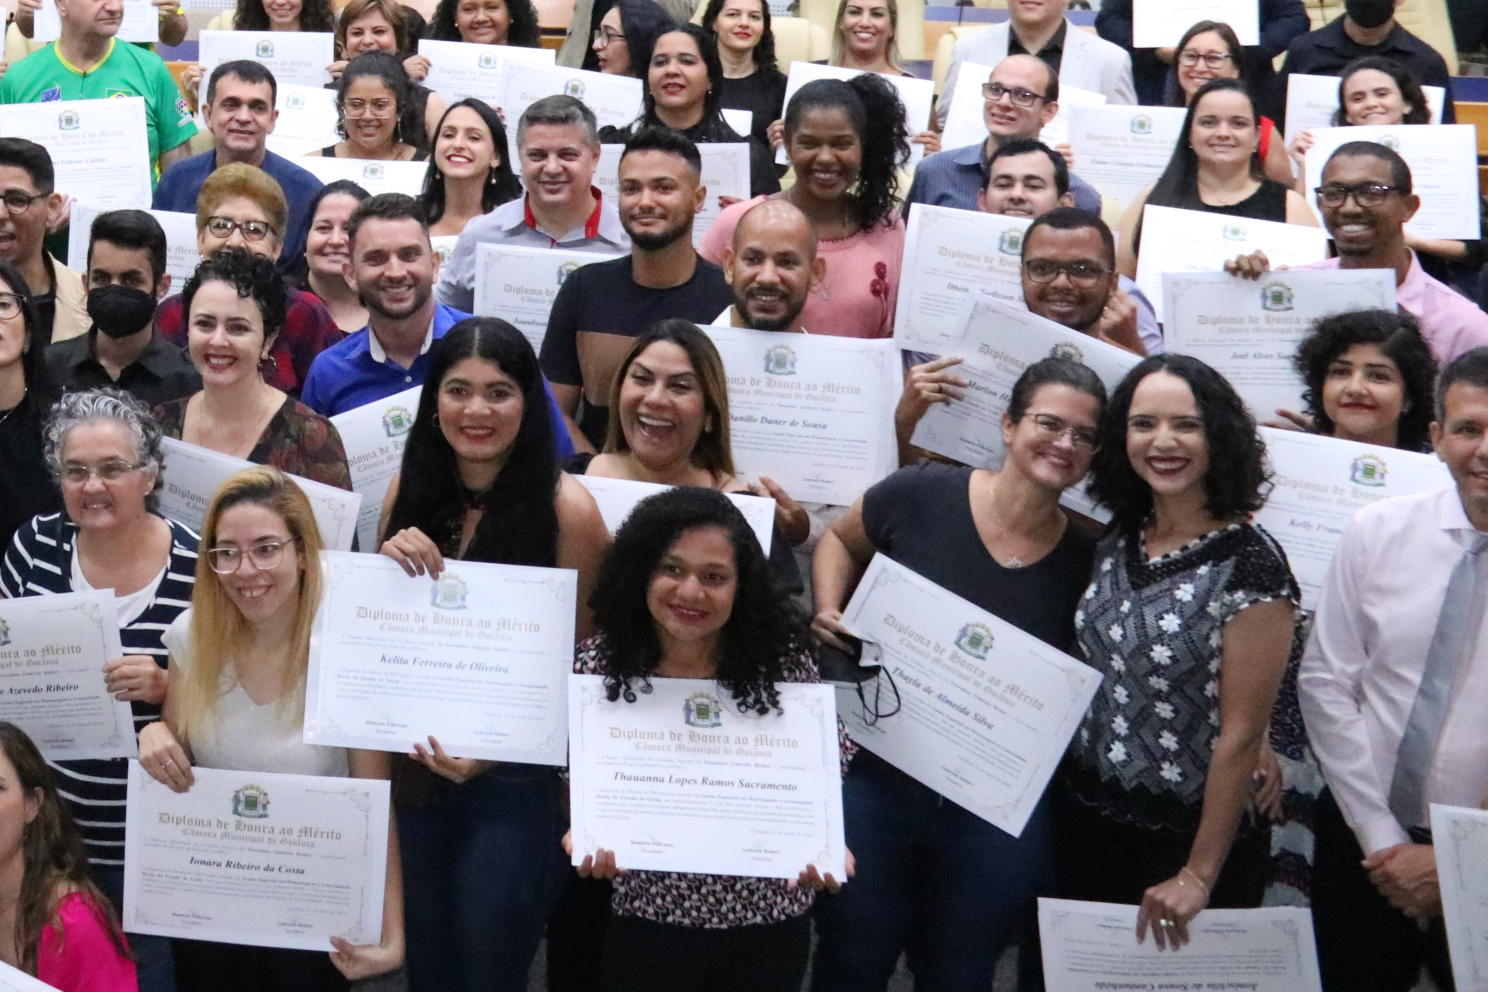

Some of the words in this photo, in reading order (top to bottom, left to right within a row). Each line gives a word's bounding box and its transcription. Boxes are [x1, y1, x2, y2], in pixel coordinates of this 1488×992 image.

[355, 605, 409, 622] Diploma
[413, 611, 427, 623] de
[431, 611, 472, 627] Honra
[476, 618, 491, 629] ao
[494, 617, 540, 633] Mérito
[23, 649, 36, 657] ao
[40, 644, 81, 657] Mérito
[881, 612, 931, 647] Diploma
[932, 641, 946, 656] de
[947, 649, 986, 678] Honra
[986, 674, 1002, 687] ao
[379, 653, 408, 665] Kelita
[411, 656, 453, 668] Ferreira
[454, 660, 467, 670] de
[469, 661, 508, 673] Oliveira
[8, 685, 43, 695] Azevedo
[45, 683, 78, 692] Ribeiro
[608, 726, 665, 741] Diploma
[668, 729, 683, 741] de
[687, 729, 729, 744] Honra
[733, 735, 748, 745] ao
[752, 733, 798, 748] Mérito
[613, 771, 665, 783] Thauanna
[667, 774, 697, 786] Lopes
[700, 776, 734, 786] Ramos
[737, 778, 797, 791] Sacramento
[158, 811, 211, 828] Diploma
[215, 818, 229, 830] de
[234, 819, 274, 834] Honra
[278, 826, 293, 836] ao
[296, 825, 341, 840] Mérito
[189, 856, 222, 867] Ionara
[224, 859, 260, 870] Ribeiro
[262, 863, 275, 872] da
[277, 865, 305, 874] Costa
